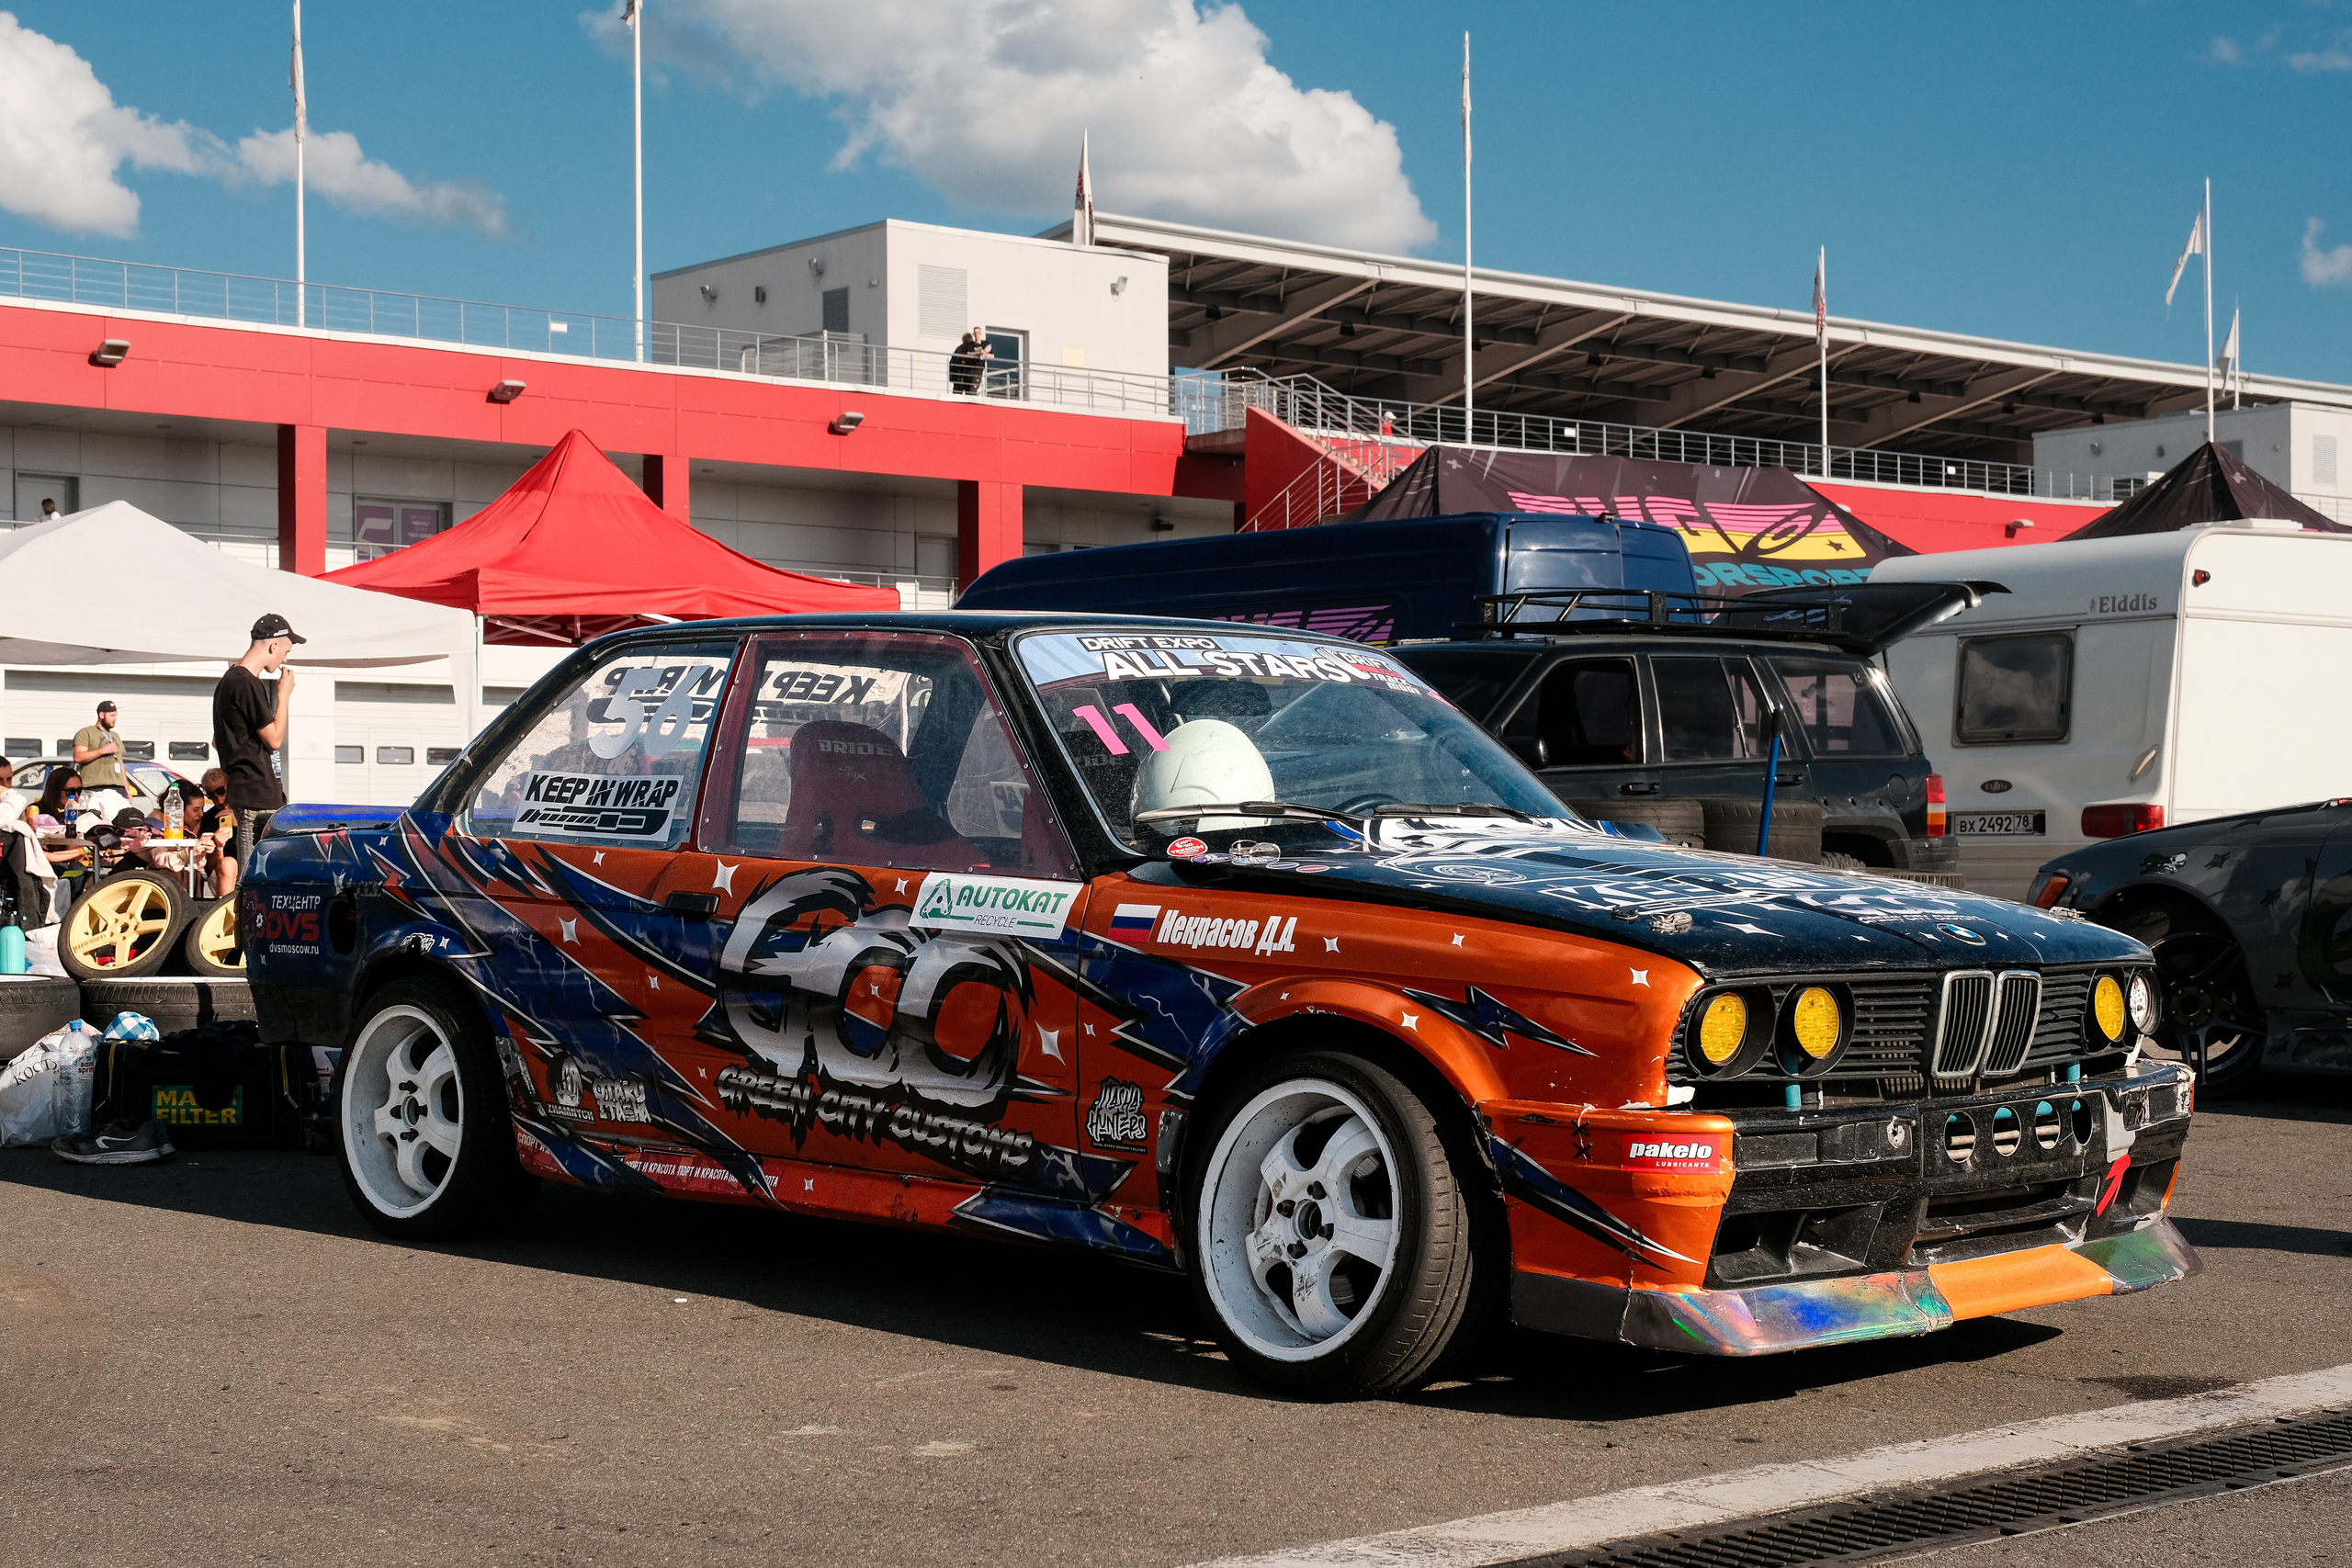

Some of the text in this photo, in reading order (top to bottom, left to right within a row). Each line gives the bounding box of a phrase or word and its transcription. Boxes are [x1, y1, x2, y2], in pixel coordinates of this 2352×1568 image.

[2098, 593, 2158, 614] Elddis
[1080, 637, 1217, 651] DRIFT EXPO
[1102, 650, 1351, 683] ALL STARS
[589, 665, 712, 760] 56
[1072, 702, 1172, 756] 11
[817, 739, 895, 757] BRIDE
[525, 774, 679, 808] KEEP IN WRAP
[1979, 817, 2012, 832] 2492
[2015, 815, 2030, 827] 78
[271, 895, 322, 912] ТЕХЦЕНТР
[956, 885, 1069, 914] AUTOKAT
[266, 912, 320, 942] DVS
[974, 914, 1017, 928] RECYCLE
[1157, 908, 1299, 956] Некрасов Д.А.
[269, 942, 320, 954] dvsmoscow.ru
[156, 1090, 237, 1107] MA
[156, 1108, 237, 1124] FILTER
[716, 1063, 1035, 1168] GREEN CITY CUSTOMS
[1629, 1142, 1713, 1159] pakelo
[648, 1163, 676, 1176] КРАСОТА
[677, 1165, 695, 1178] ПОРТ
[700, 1168, 729, 1182] КРАСОТА
